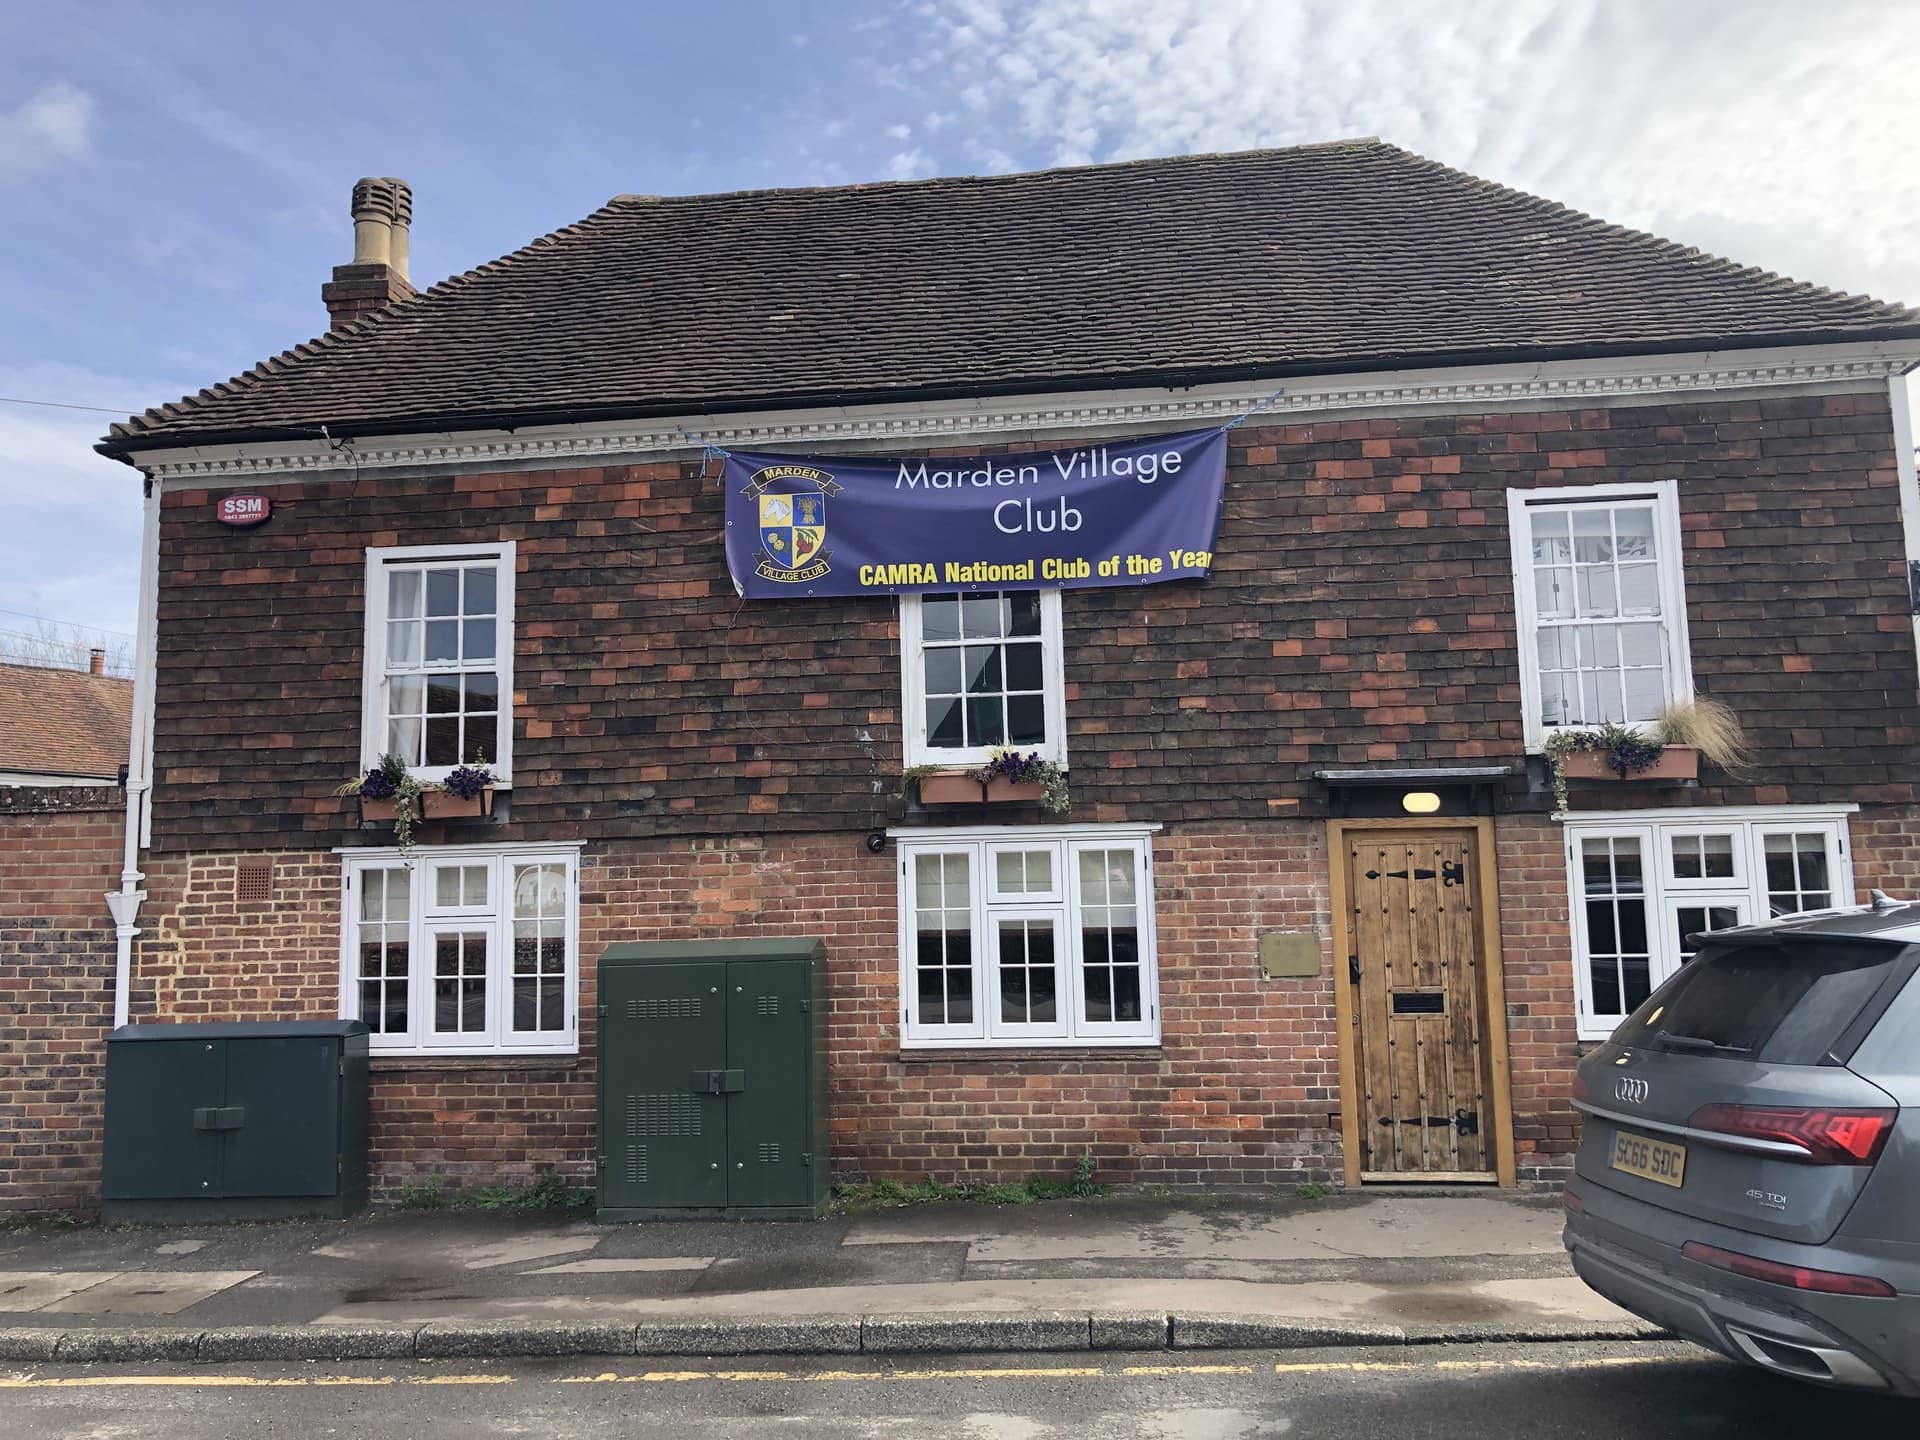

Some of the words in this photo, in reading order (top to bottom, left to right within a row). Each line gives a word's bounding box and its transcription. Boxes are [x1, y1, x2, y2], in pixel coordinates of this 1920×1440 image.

[764, 467, 820, 481] MARDEN
[895, 461, 1038, 490] Marden
[1052, 448, 1182, 484] Village
[224, 498, 262, 513] SSM
[993, 496, 1083, 534] Club
[763, 567, 799, 580] VILLAGE
[801, 565, 825, 579] CLUB
[859, 562, 938, 586] CAMRA
[944, 559, 1034, 583] National
[1042, 556, 1091, 580] Club
[1098, 555, 1121, 577] of
[1126, 554, 1163, 576] the
[1169, 548, 1213, 570] Year
[1616, 1137, 1649, 1169] SC66
[1651, 1146, 1681, 1178] SDC
[1745, 1189, 1763, 1199] 45
[1765, 1191, 1787, 1204] TDI
